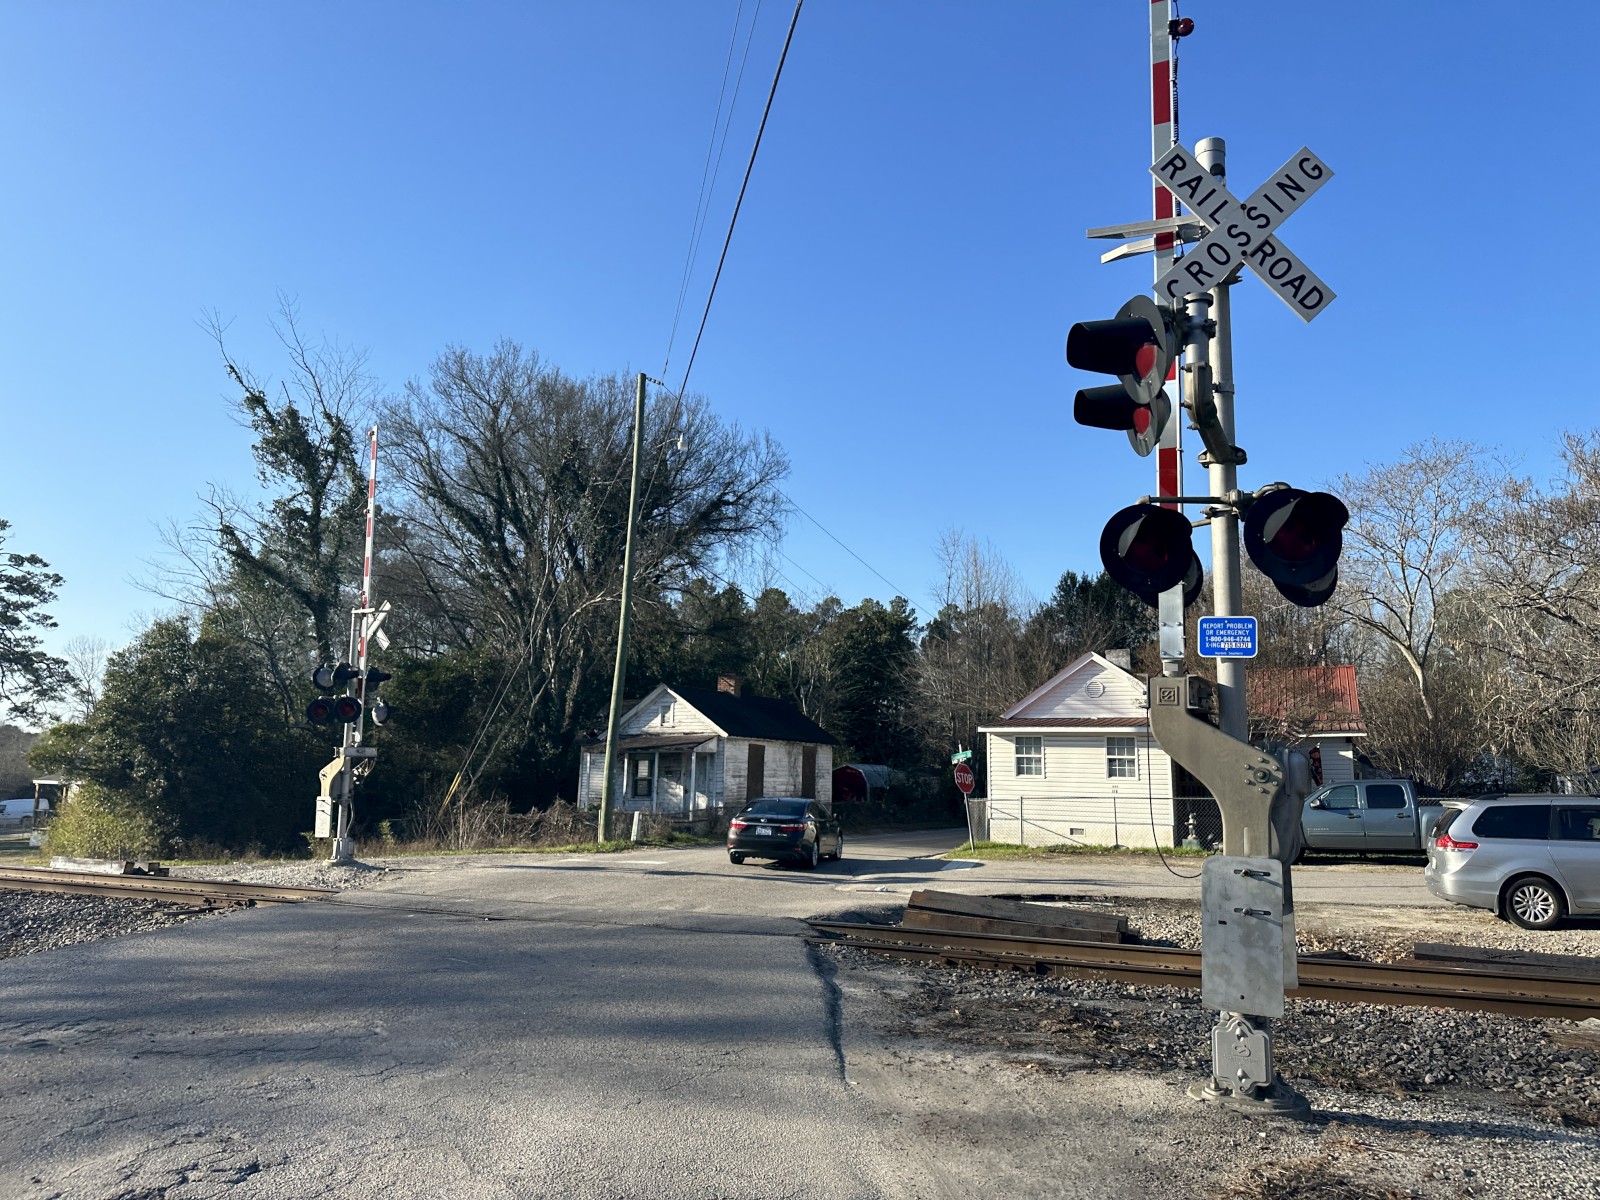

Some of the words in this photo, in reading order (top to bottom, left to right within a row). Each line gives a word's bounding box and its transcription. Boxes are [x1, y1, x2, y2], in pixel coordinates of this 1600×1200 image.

[1160, 153, 1229, 226] RAIL
[1250, 239, 1324, 311] ROAD
[1166, 157, 1323, 299] CROSSING
[956, 772, 973, 785] STOP
